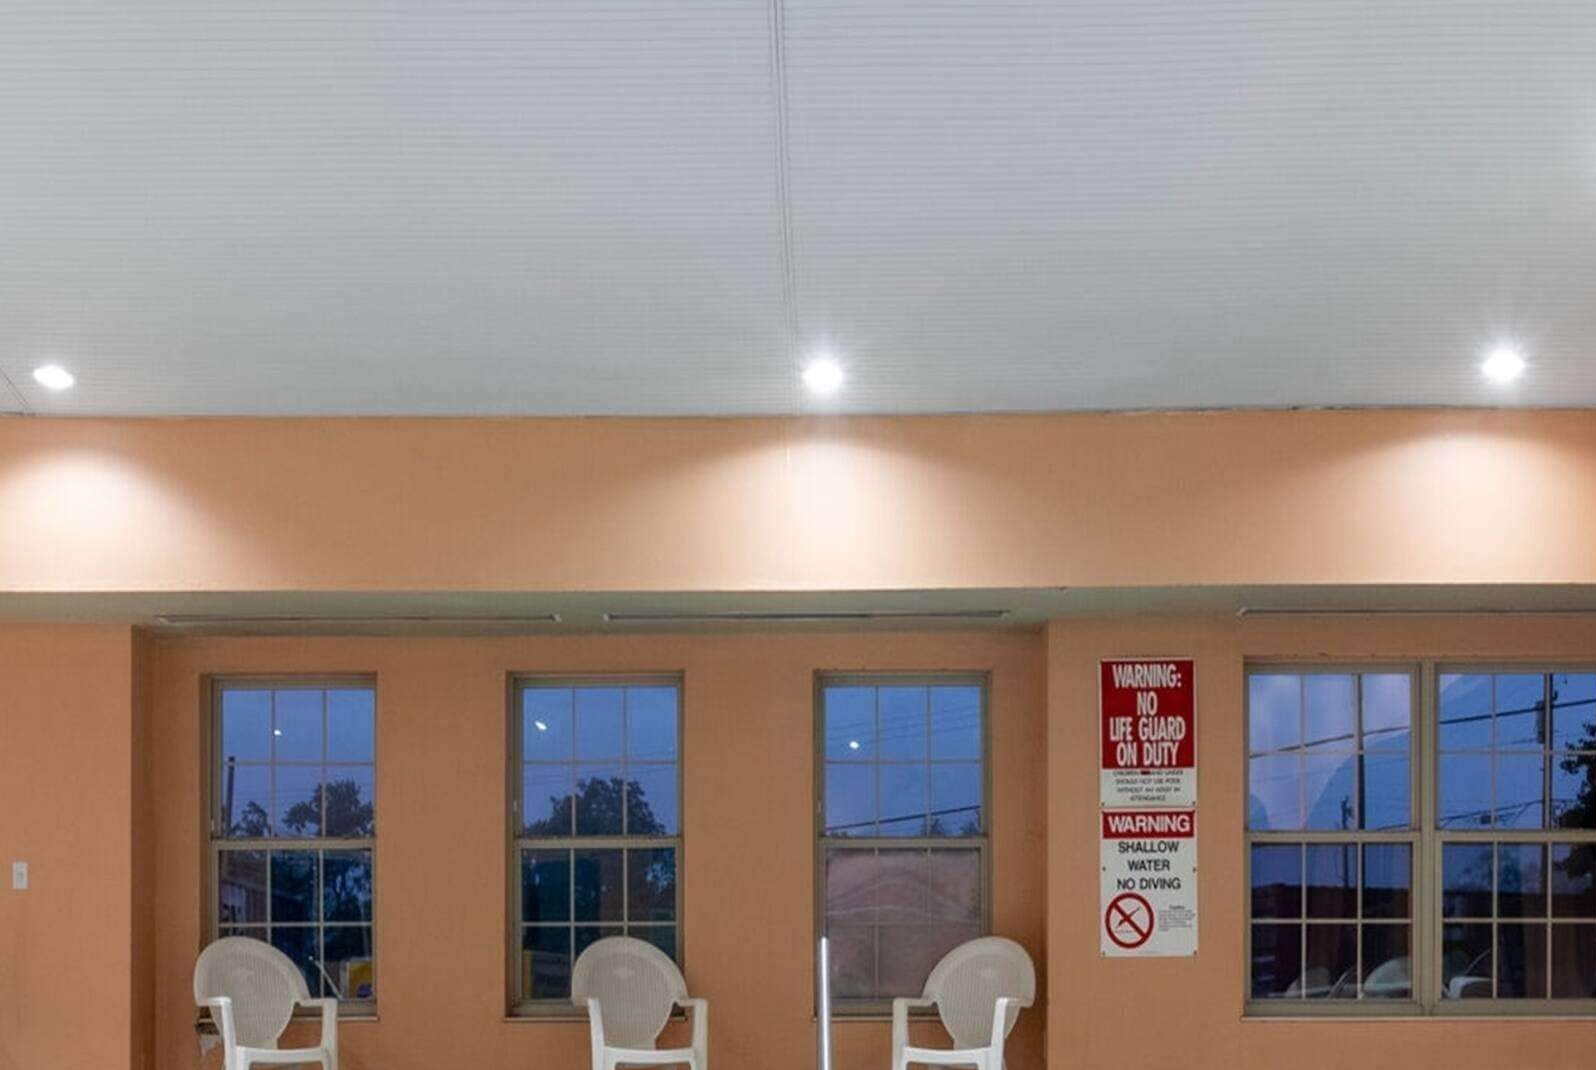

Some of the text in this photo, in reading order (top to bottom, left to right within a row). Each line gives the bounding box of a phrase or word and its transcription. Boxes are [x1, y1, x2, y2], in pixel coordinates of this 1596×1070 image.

[1112, 664, 1182, 688] WARNING:
[1136, 691, 1158, 716] NO
[1109, 716, 1186, 741] LIFE GUARD
[1116, 742, 1180, 766] ON DUTY
[1108, 815, 1190, 833] WARNING
[1118, 841, 1179, 853] SHALLOW
[1127, 859, 1170, 871] WATER
[1116, 878, 1181, 890] NO DIVING
